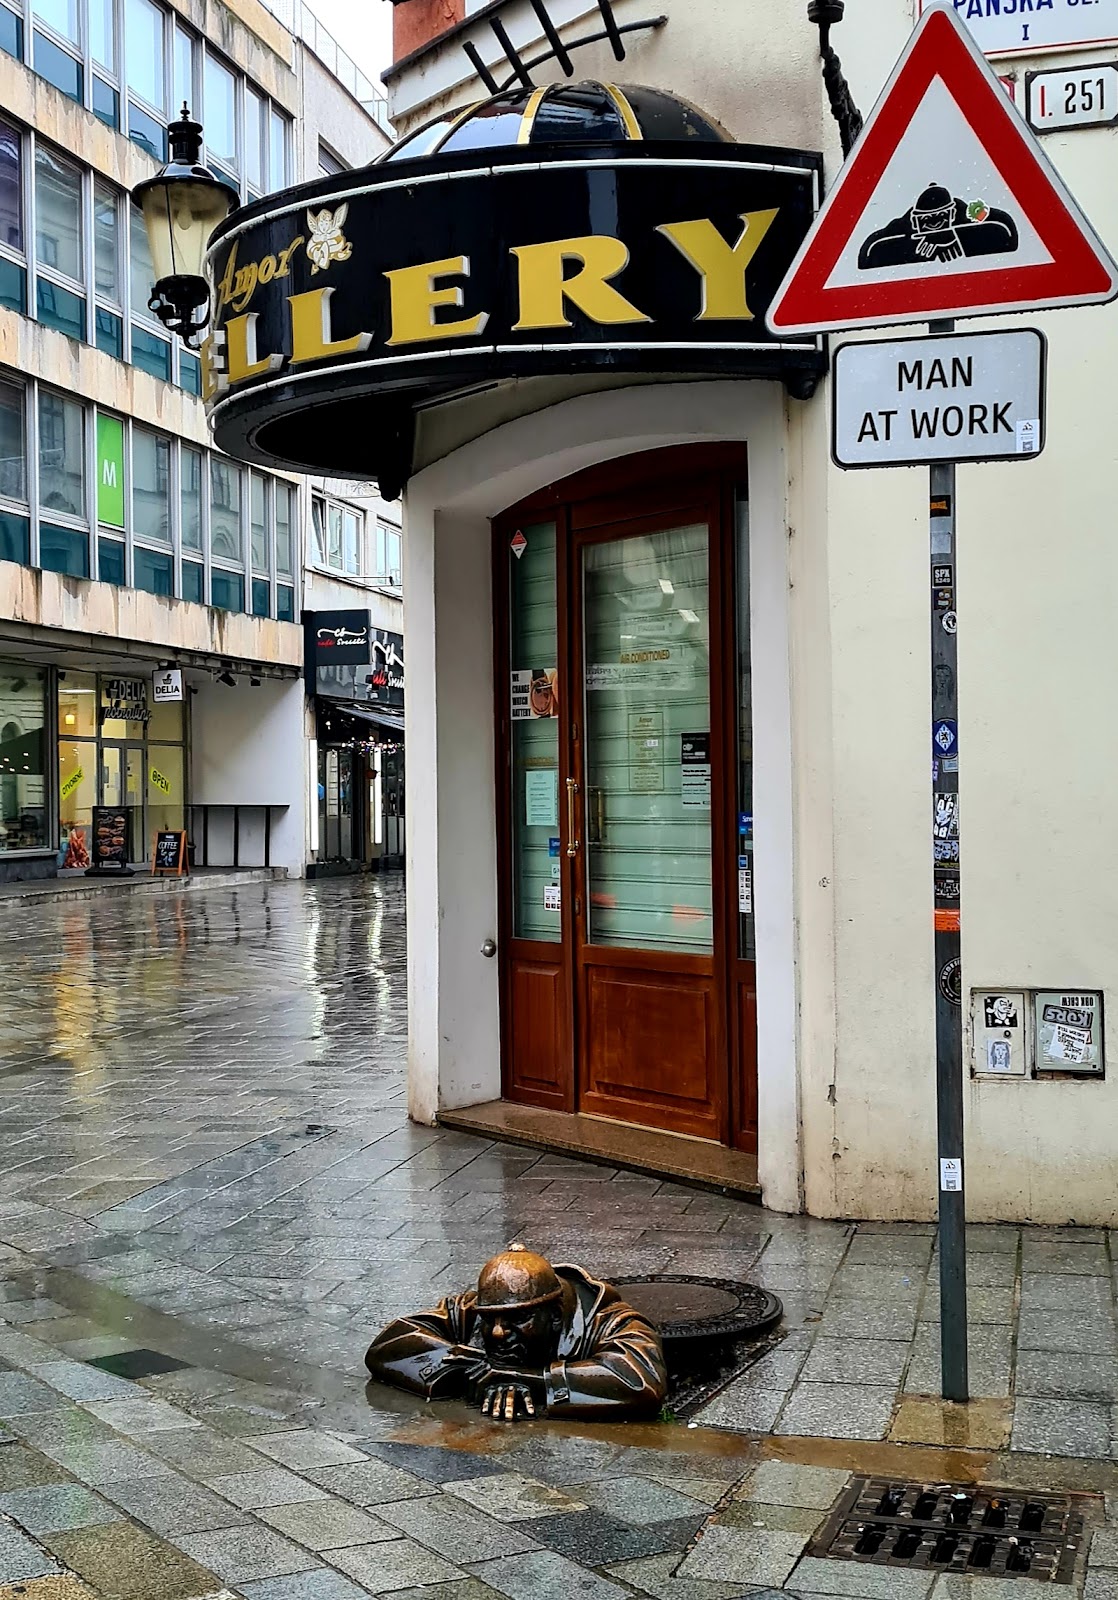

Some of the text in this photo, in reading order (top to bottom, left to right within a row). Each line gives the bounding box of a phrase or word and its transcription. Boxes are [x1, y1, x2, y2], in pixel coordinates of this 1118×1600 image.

[1022, 24, 1029, 41] I
[1064, 78, 1105, 114] 251
[218, 234, 305, 313] Amor
[897, 356, 973, 391] MAN
[857, 401, 1014, 442] AT WORK
[103, 459, 117, 488] M
[119, 681, 147, 702] DELIA
[155, 685, 180, 694] DELIA
[152, 770, 170, 792] OPEN
[158, 841, 178, 850] COFFEE
